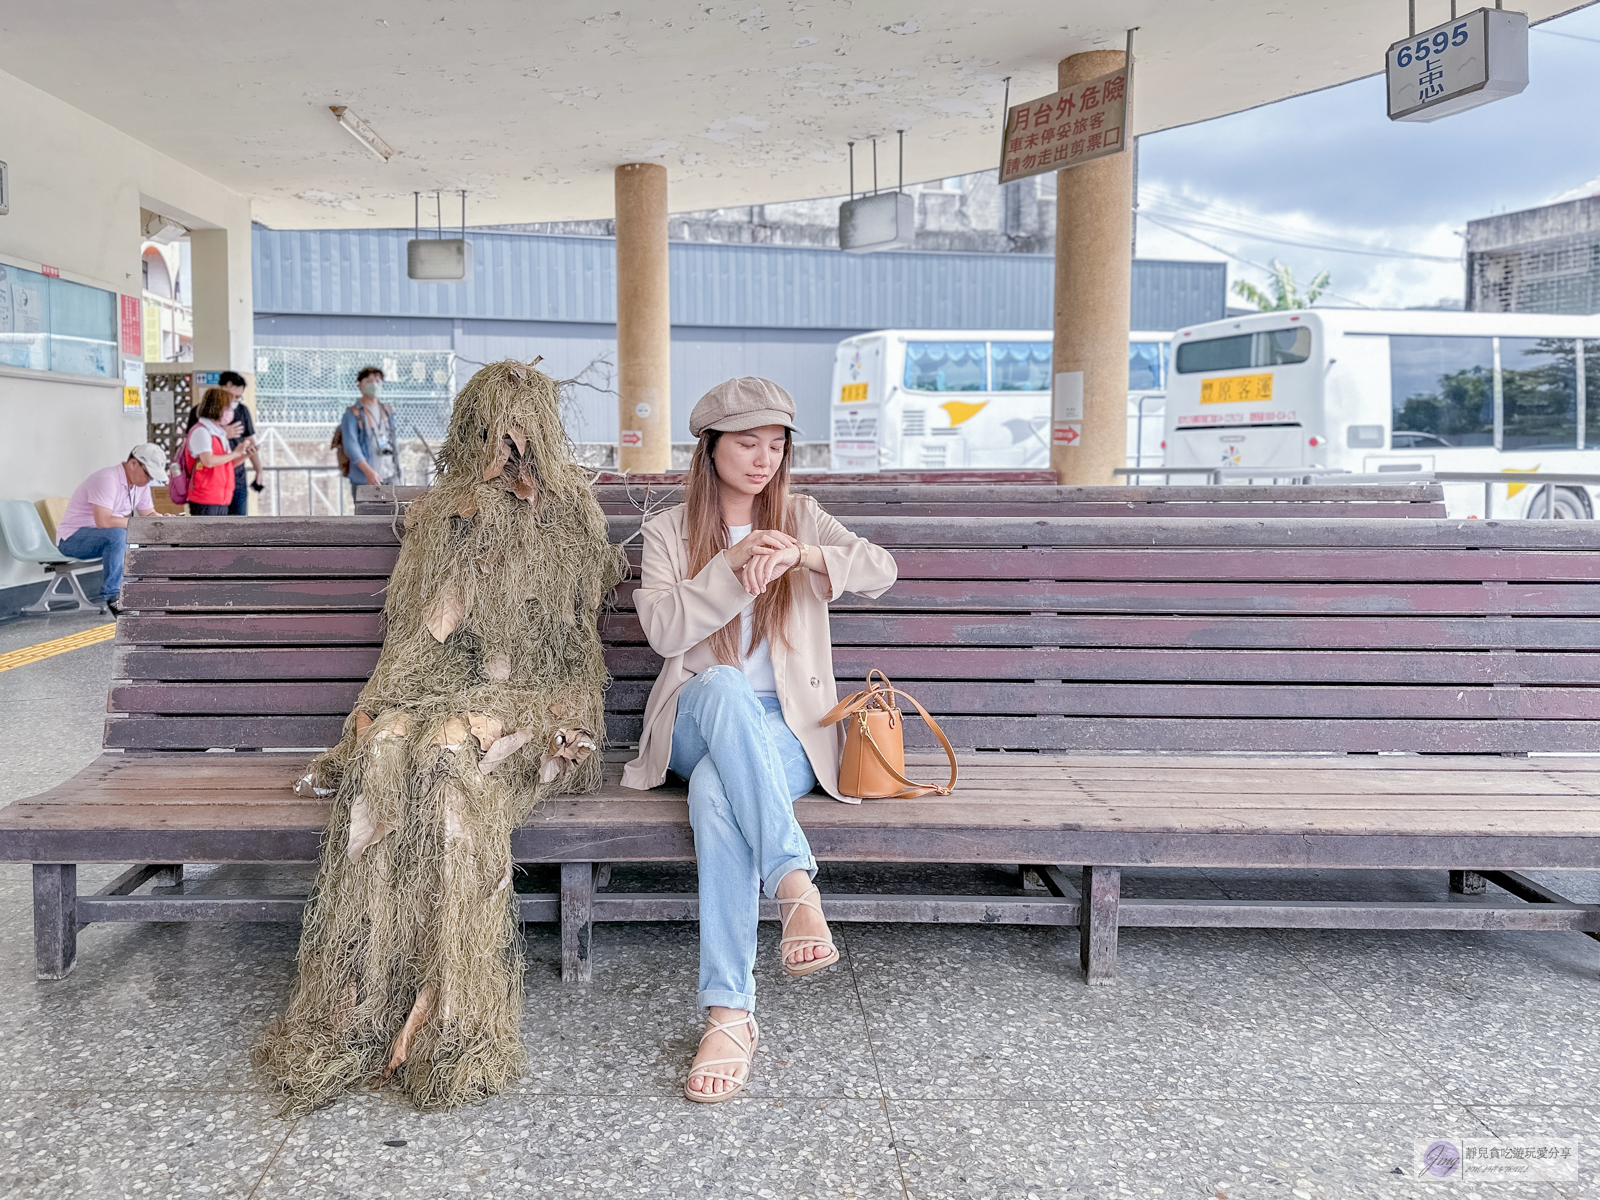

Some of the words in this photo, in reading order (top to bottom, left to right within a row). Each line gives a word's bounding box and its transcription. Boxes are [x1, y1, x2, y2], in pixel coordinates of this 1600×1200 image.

[1397, 22, 1469, 68] 6595
[1011, 75, 1125, 134] 月台外危險
[1005, 126, 1120, 175] 請勿走出剪票口
[1007, 111, 1105, 154] 車未停妥旅客
